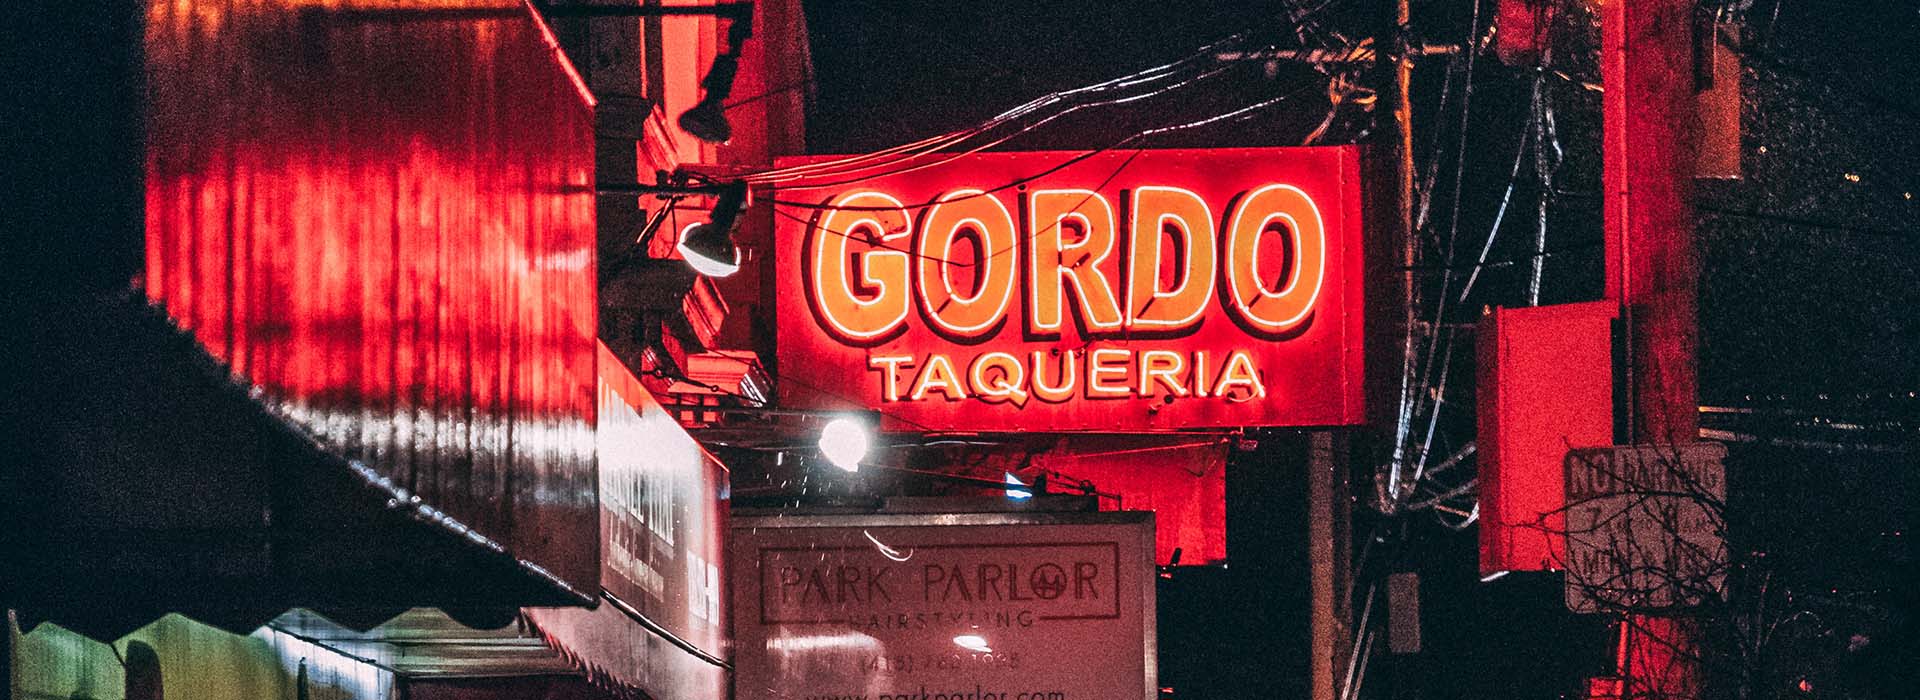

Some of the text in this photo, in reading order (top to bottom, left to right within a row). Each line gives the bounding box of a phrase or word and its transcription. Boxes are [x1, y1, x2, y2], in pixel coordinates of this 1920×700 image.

[804, 182, 1327, 345] GORDO
[868, 349, 1267, 404] TAQUERIA
[1571, 453, 1610, 494] NO
[781, 561, 1099, 603] PARK PARLOR
